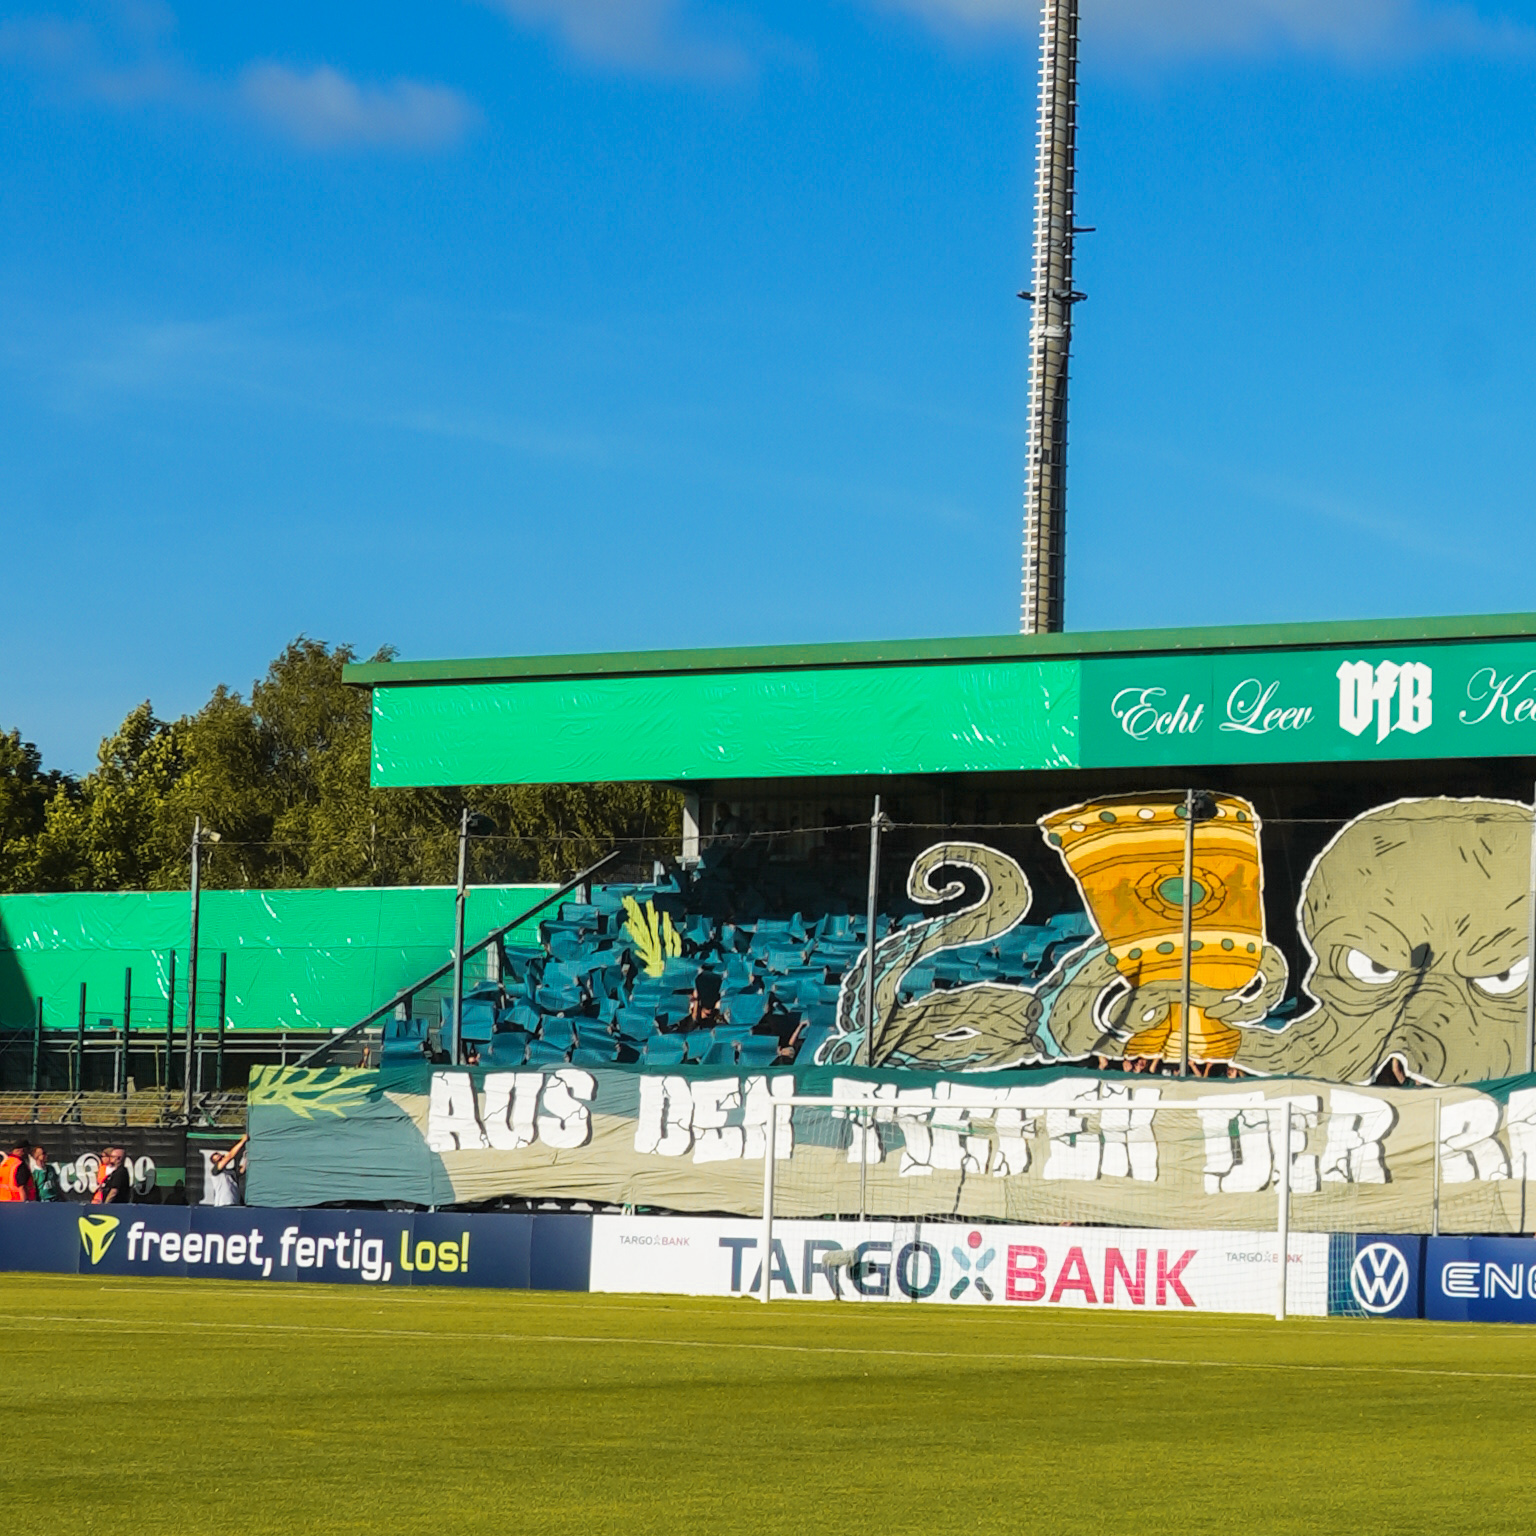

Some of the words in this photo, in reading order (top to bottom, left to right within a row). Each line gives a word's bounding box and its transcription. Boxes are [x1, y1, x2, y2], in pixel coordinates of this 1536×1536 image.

[1111, 686, 1203, 741] Echt
[1336, 659, 1433, 745] VfB
[428, 1068, 596, 1153] AUS
[634, 1074, 796, 1165] DEN
[1197, 1088, 1400, 1196] DER
[127, 1222, 274, 1277] freenet,
[279, 1225, 393, 1282] fertig,
[400, 1230, 469, 1274] los!
[1225, 1250, 1304, 1264] TARGOBNK
